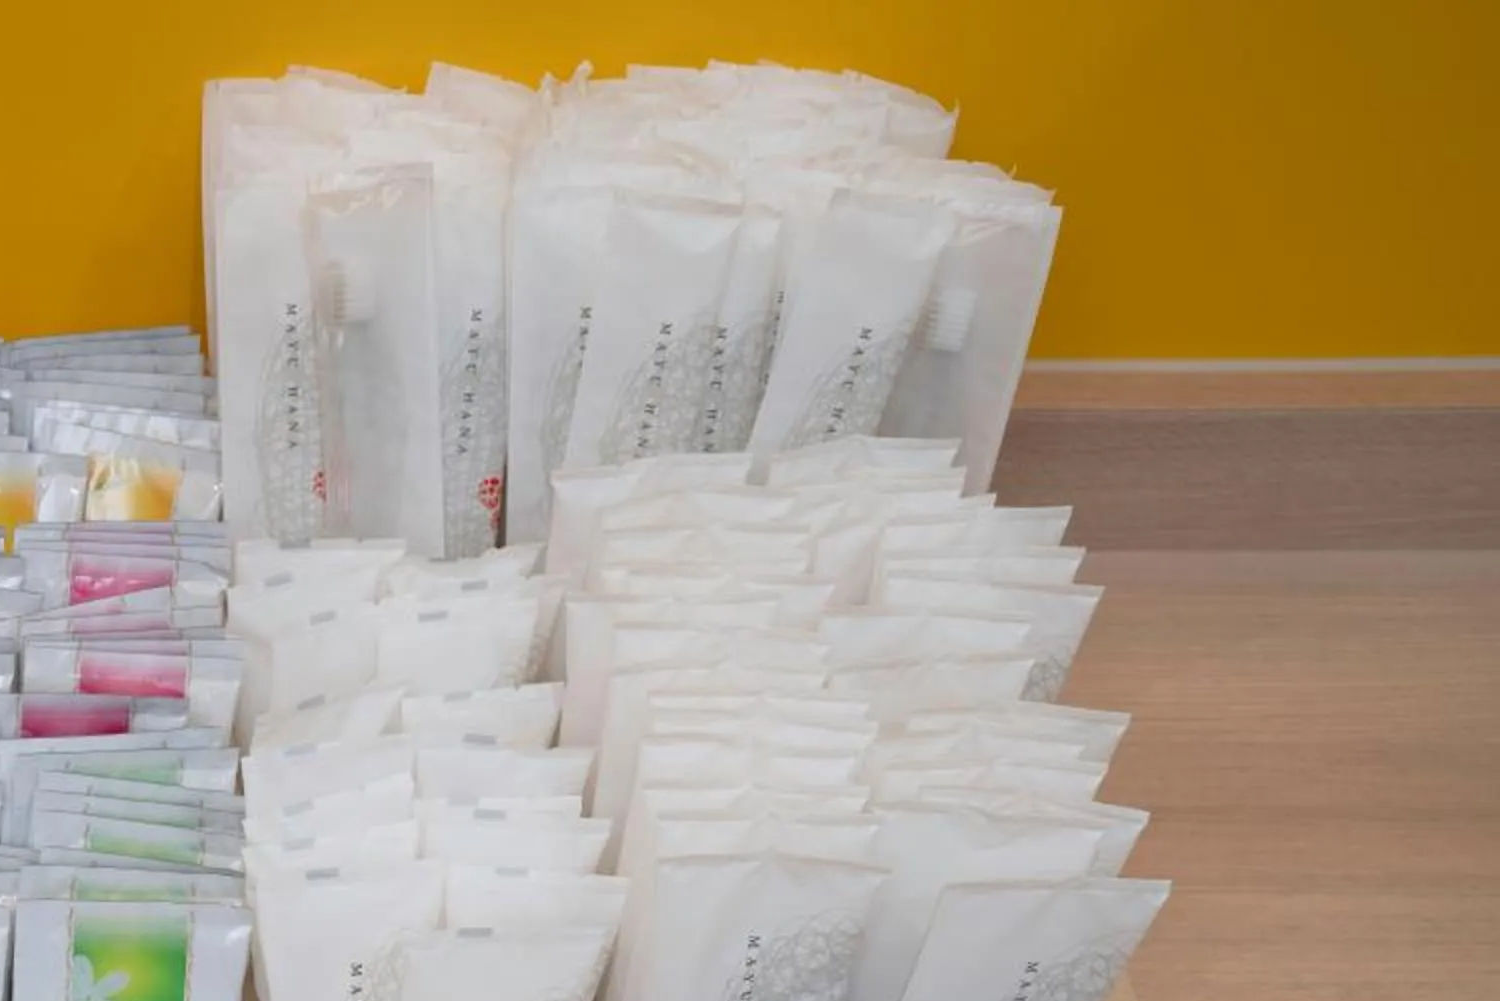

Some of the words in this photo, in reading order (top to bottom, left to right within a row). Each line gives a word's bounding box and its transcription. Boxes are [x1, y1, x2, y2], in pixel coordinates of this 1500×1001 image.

[286, 386, 301, 450] HANA
[456, 392, 477, 456] HANA
[634, 403, 659, 459] HAN
[703, 408, 719, 453] HAN
